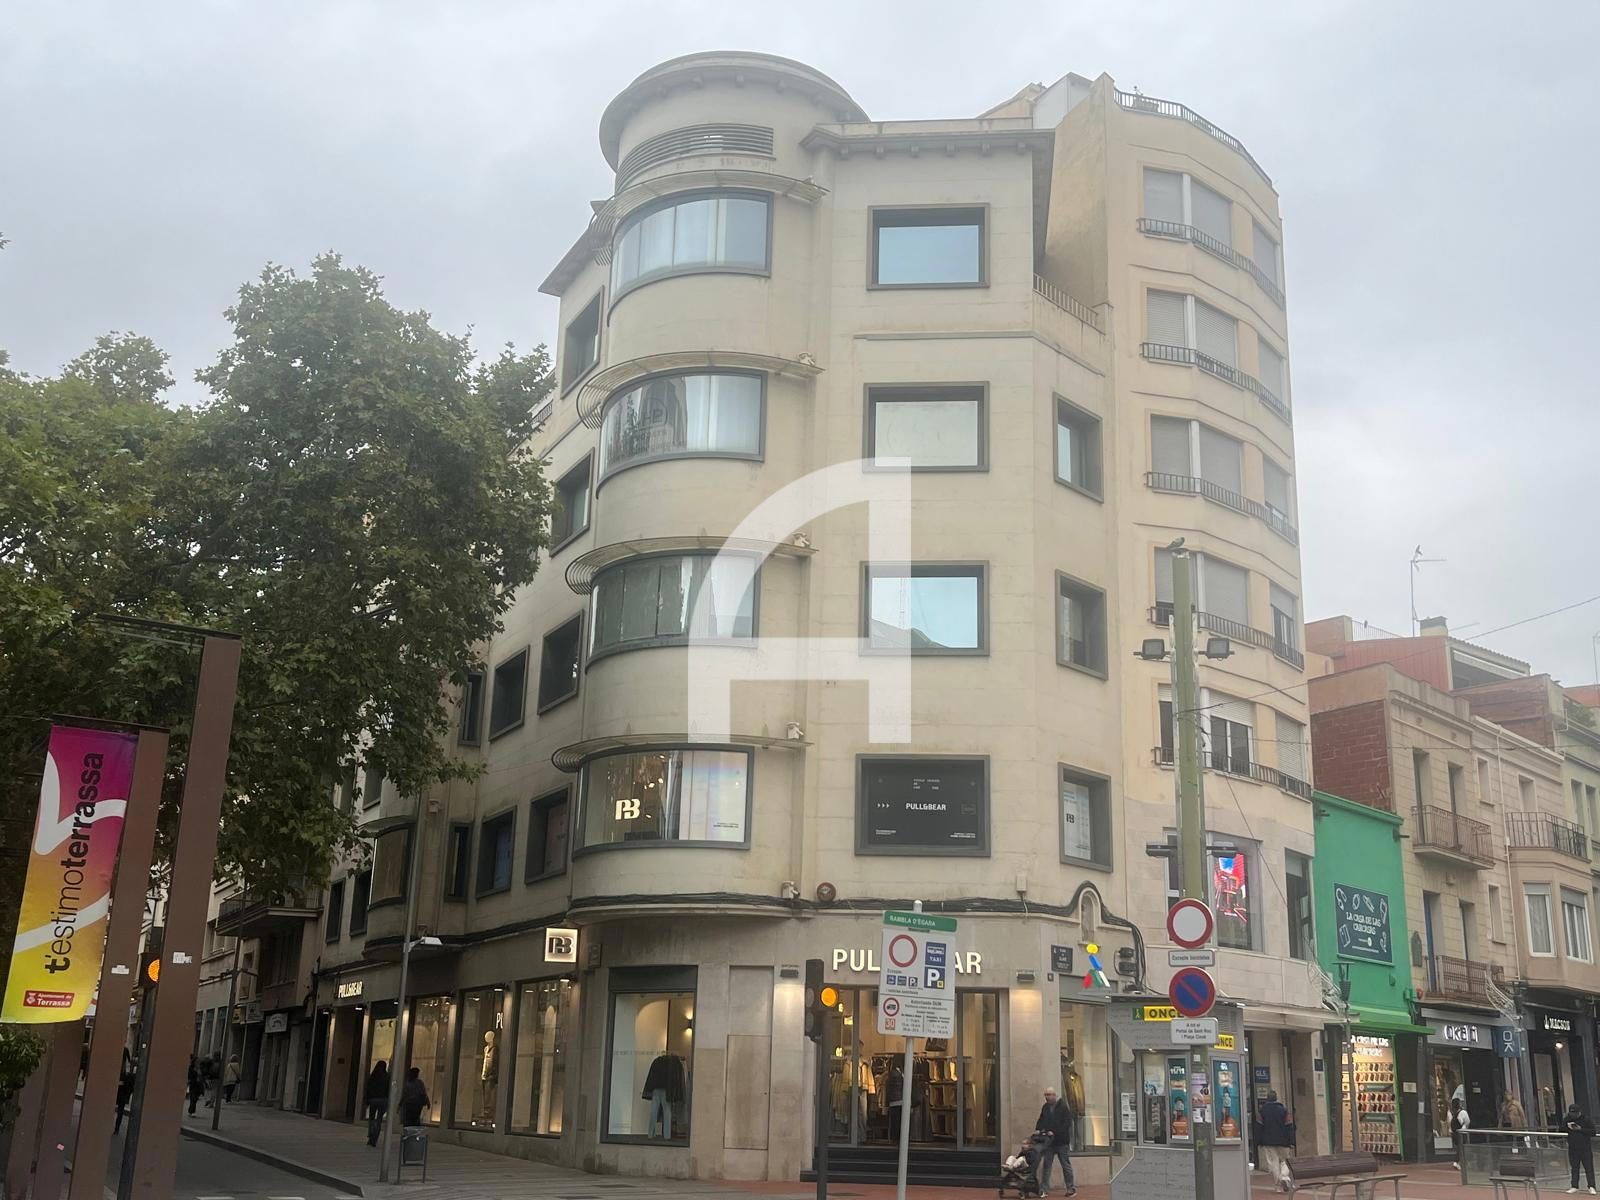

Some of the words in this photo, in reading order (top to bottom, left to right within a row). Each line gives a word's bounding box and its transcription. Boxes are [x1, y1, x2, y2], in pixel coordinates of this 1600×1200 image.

[905, 803, 947, 811] PULL&BEAR
[889, 915, 911, 925] RAMBLA
[37, 998, 71, 1007] Terrassa
[1148, 1008, 1185, 1018] ONC
